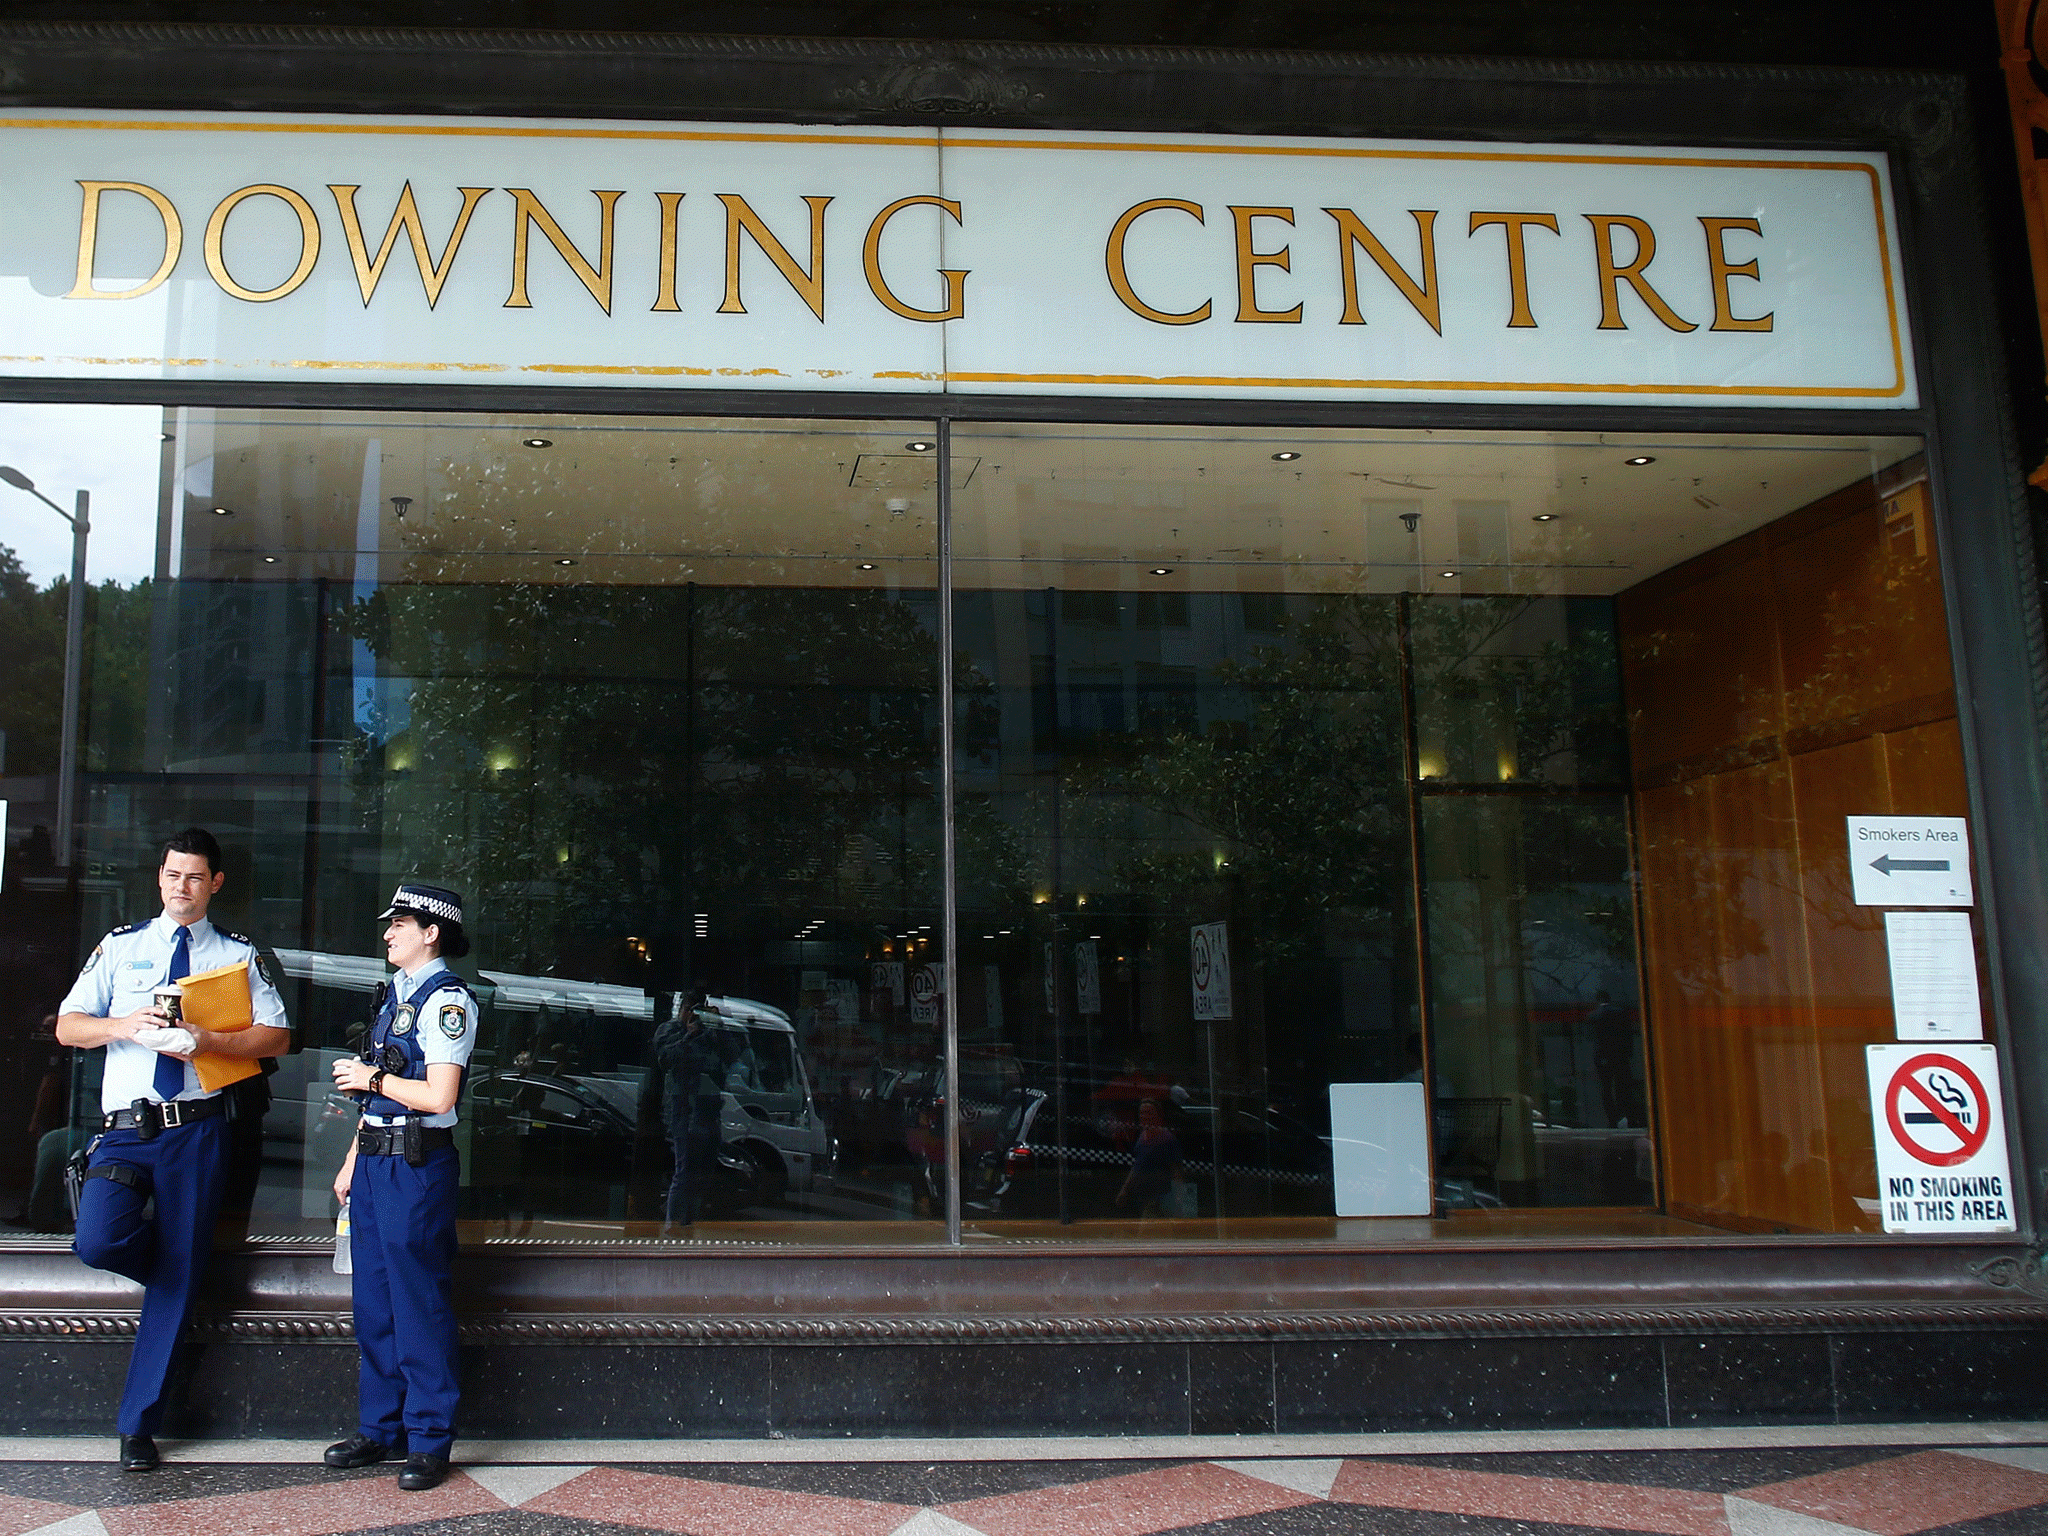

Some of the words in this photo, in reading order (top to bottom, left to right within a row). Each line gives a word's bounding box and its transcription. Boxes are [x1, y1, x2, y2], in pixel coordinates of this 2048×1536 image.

[62, 178, 972, 325] DOWNING
[1104, 198, 1776, 338] CENTRE
[1858, 827, 1920, 841] Smokers
[1925, 829, 1959, 842] Area
[1889, 1177, 1914, 1198] NO
[1921, 1176, 2003, 1197] SMOKING
[1890, 1201, 1908, 1221] IN
[1914, 1201, 1955, 1221] THIS
[1961, 1200, 2008, 1221] AREA
